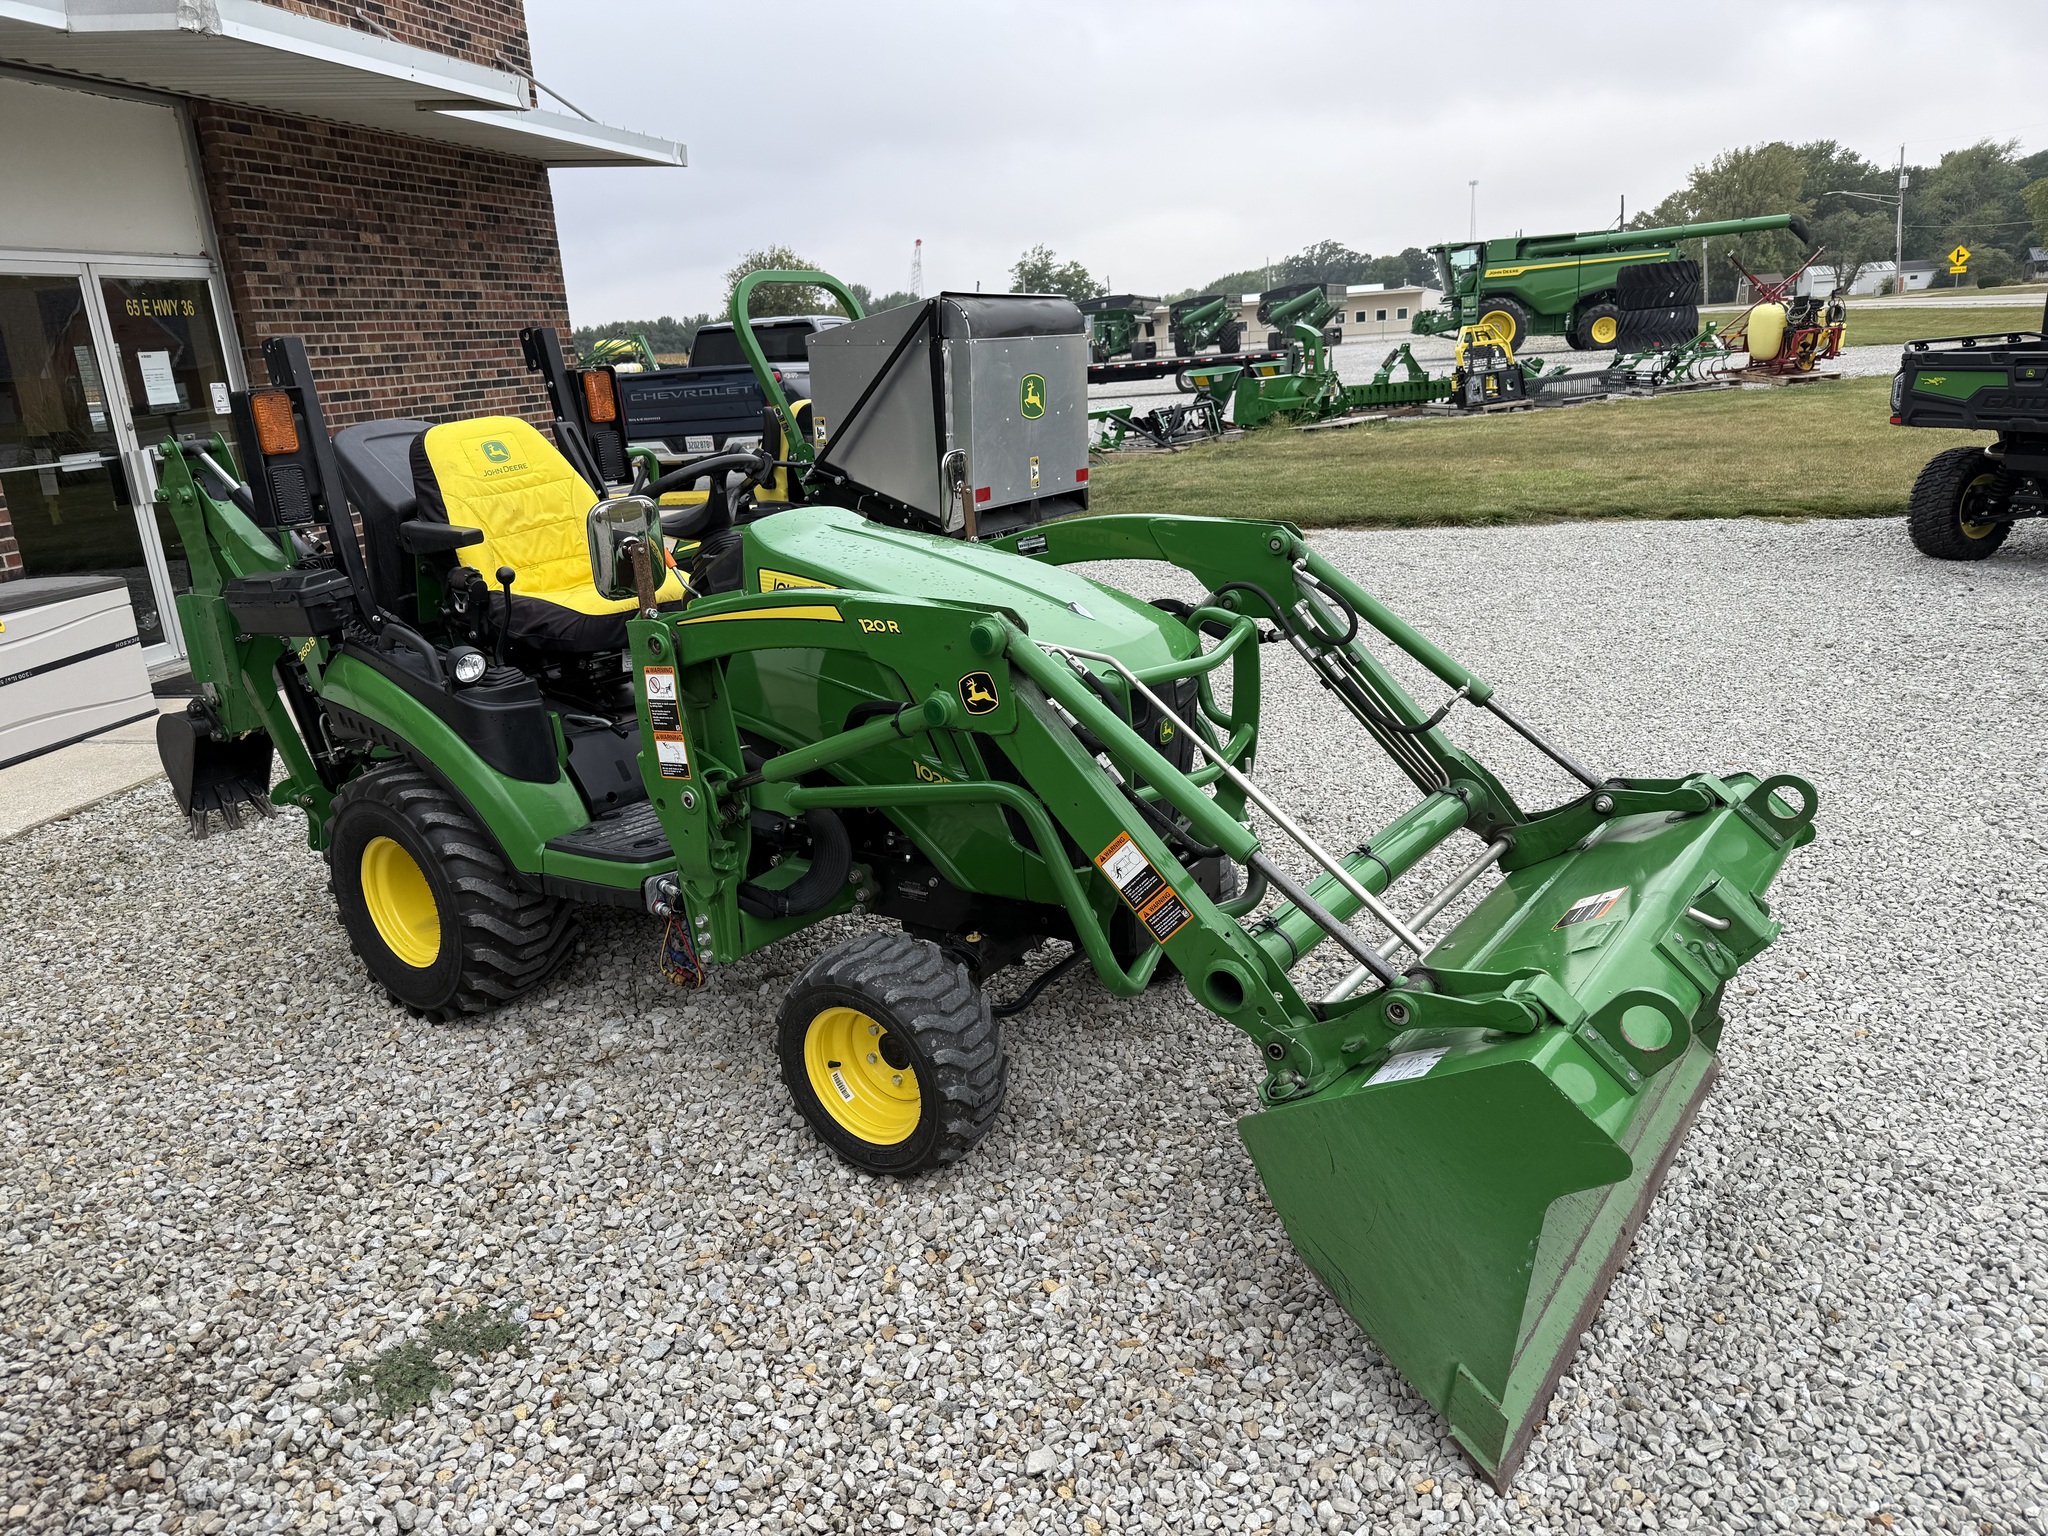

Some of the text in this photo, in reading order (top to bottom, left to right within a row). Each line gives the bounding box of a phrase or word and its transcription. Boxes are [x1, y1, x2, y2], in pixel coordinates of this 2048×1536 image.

[126, 299, 195, 316] 65 E HWY 36
[630, 386, 752, 402] CHEVROLET
[484, 463, 528, 477] JOHN DEERE
[858, 618, 901, 634] 120 R
[298, 636, 316, 662] 260 B
[1103, 836, 1126, 858] WARNING
[1148, 891, 1171, 913] WARNING
